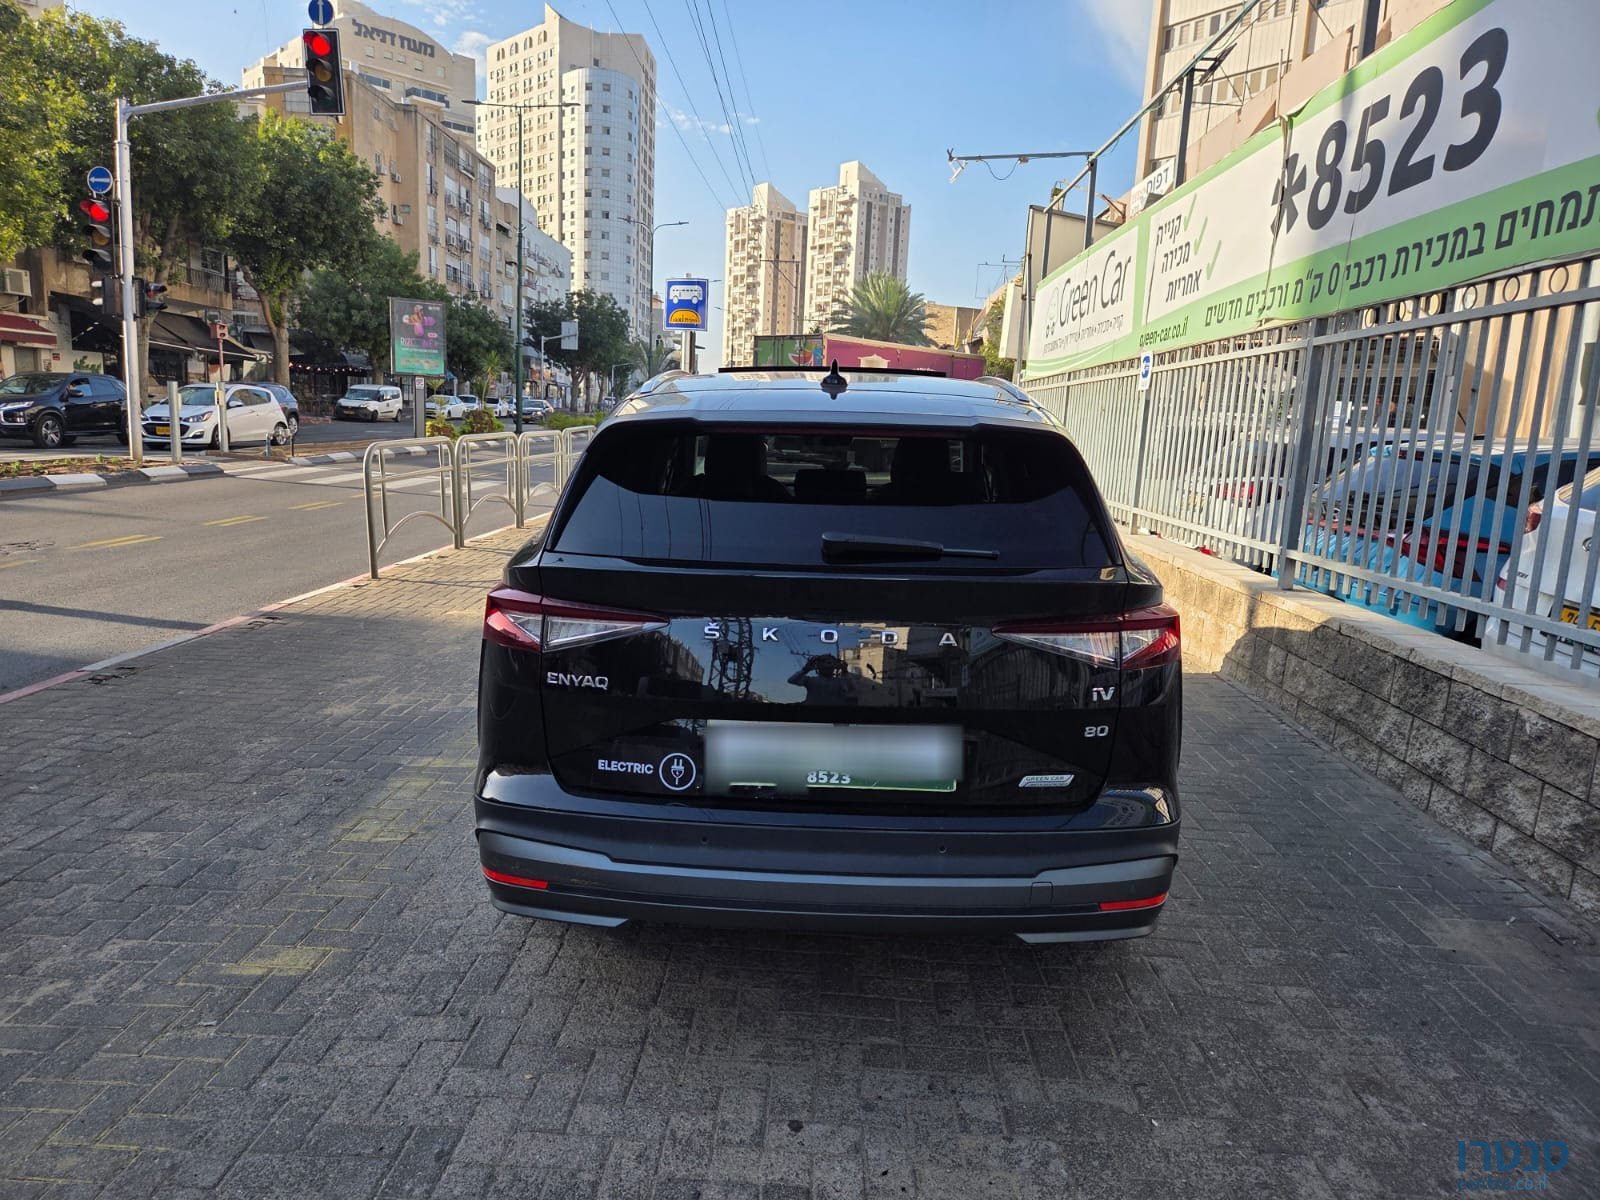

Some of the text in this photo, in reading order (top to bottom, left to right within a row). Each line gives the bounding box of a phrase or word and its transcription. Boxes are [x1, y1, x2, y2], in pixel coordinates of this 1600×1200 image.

[352, 18, 397, 47] דניאל
[1156, 214, 1182, 245] קנייה
[1161, 241, 1191, 274] מכירה
[1391, 222, 1487, 280] במכירת
[1165, 268, 1202, 303] אחריות
[1327, 261, 1341, 296] 0
[1344, 252, 1387, 291] רכבי
[1059, 249, 1132, 328] Green Car
[1204, 297, 1243, 327] חדשים
[704, 621, 958, 647] ŠKODA
[546, 671, 609, 691] ENYAQ
[1084, 725, 1109, 738] 80
[597, 758, 654, 775] ELECTRIC
[806, 770, 851, 785] 8523
